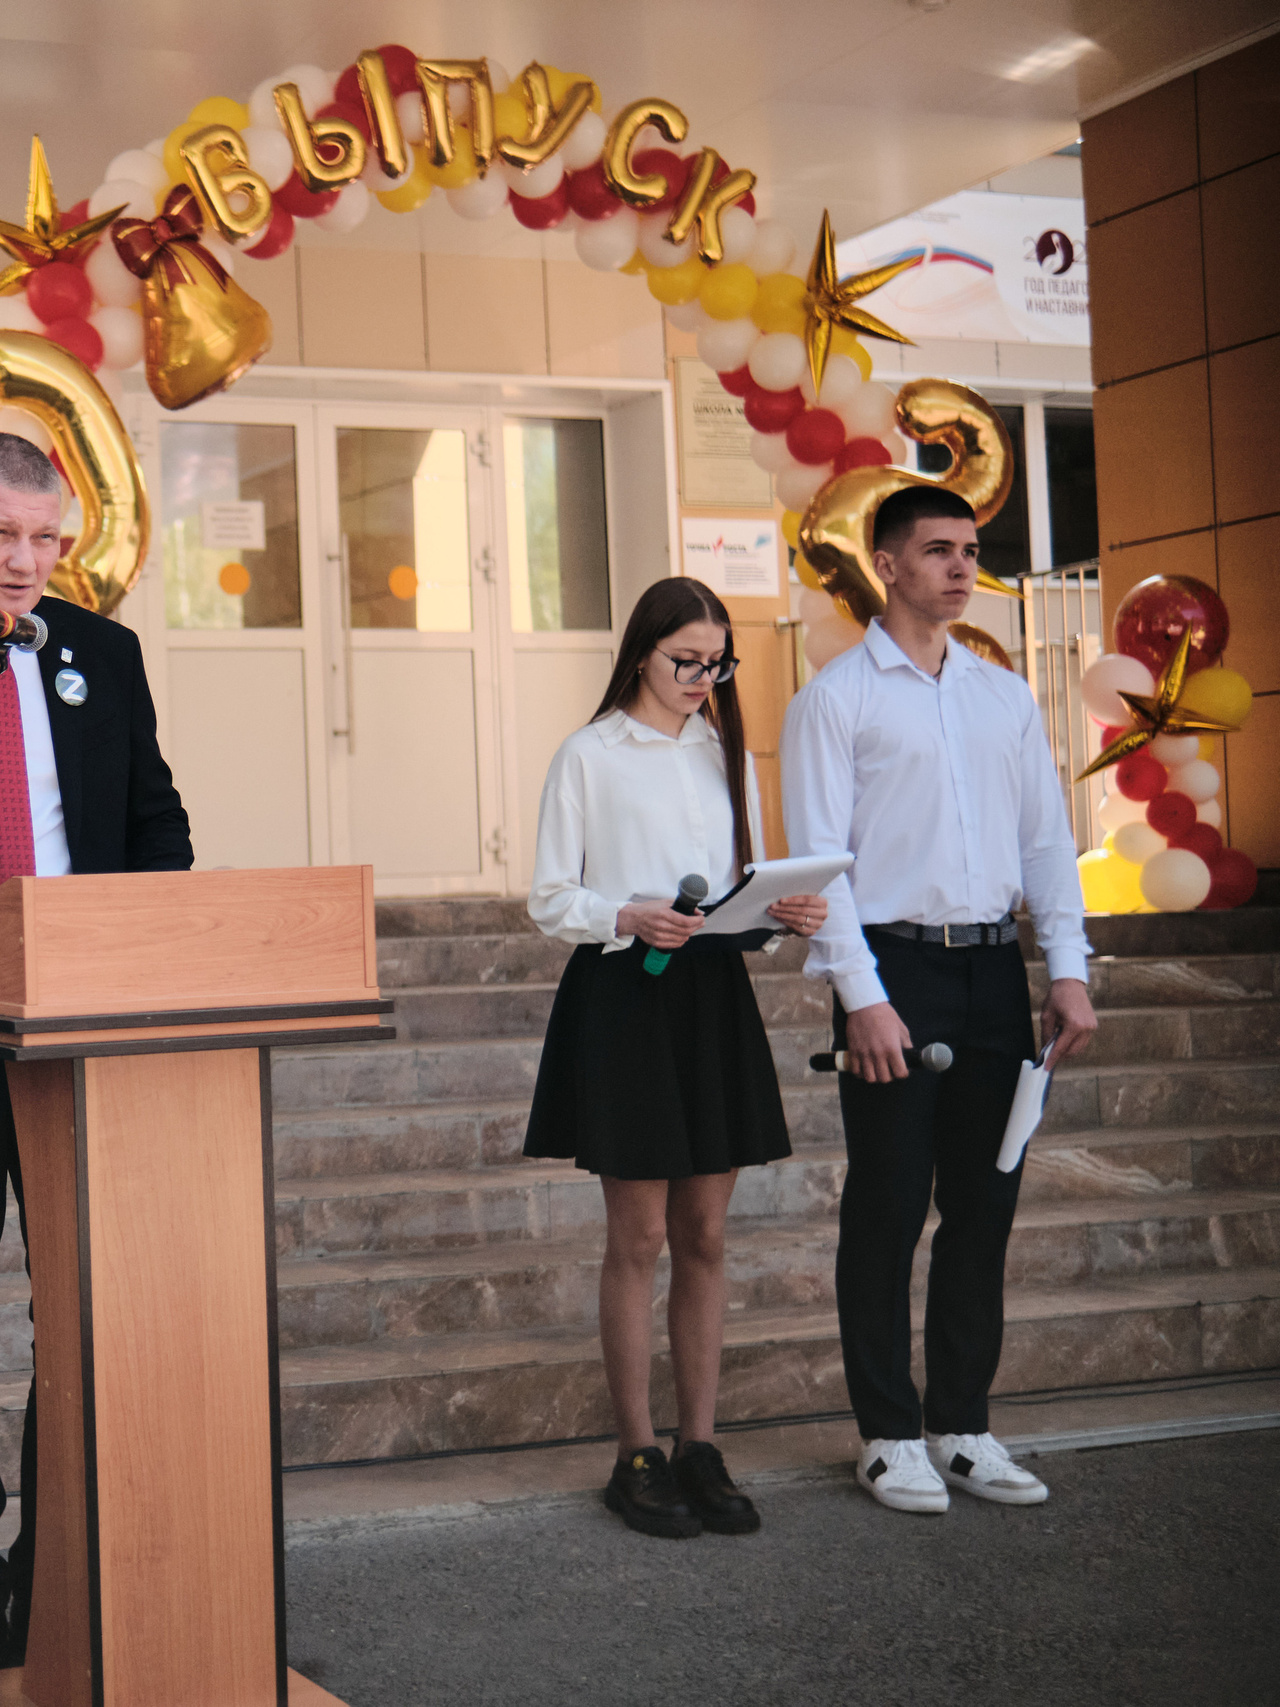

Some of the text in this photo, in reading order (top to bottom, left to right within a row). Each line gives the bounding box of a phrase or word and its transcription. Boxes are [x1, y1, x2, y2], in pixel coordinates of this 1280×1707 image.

[179, 49, 757, 265] ВЫПУСК
[1024, 276, 1045, 295] ГОД
[1035, 298, 1088, 316] НАСТАВНИ
[61, 673, 86, 702] Z
